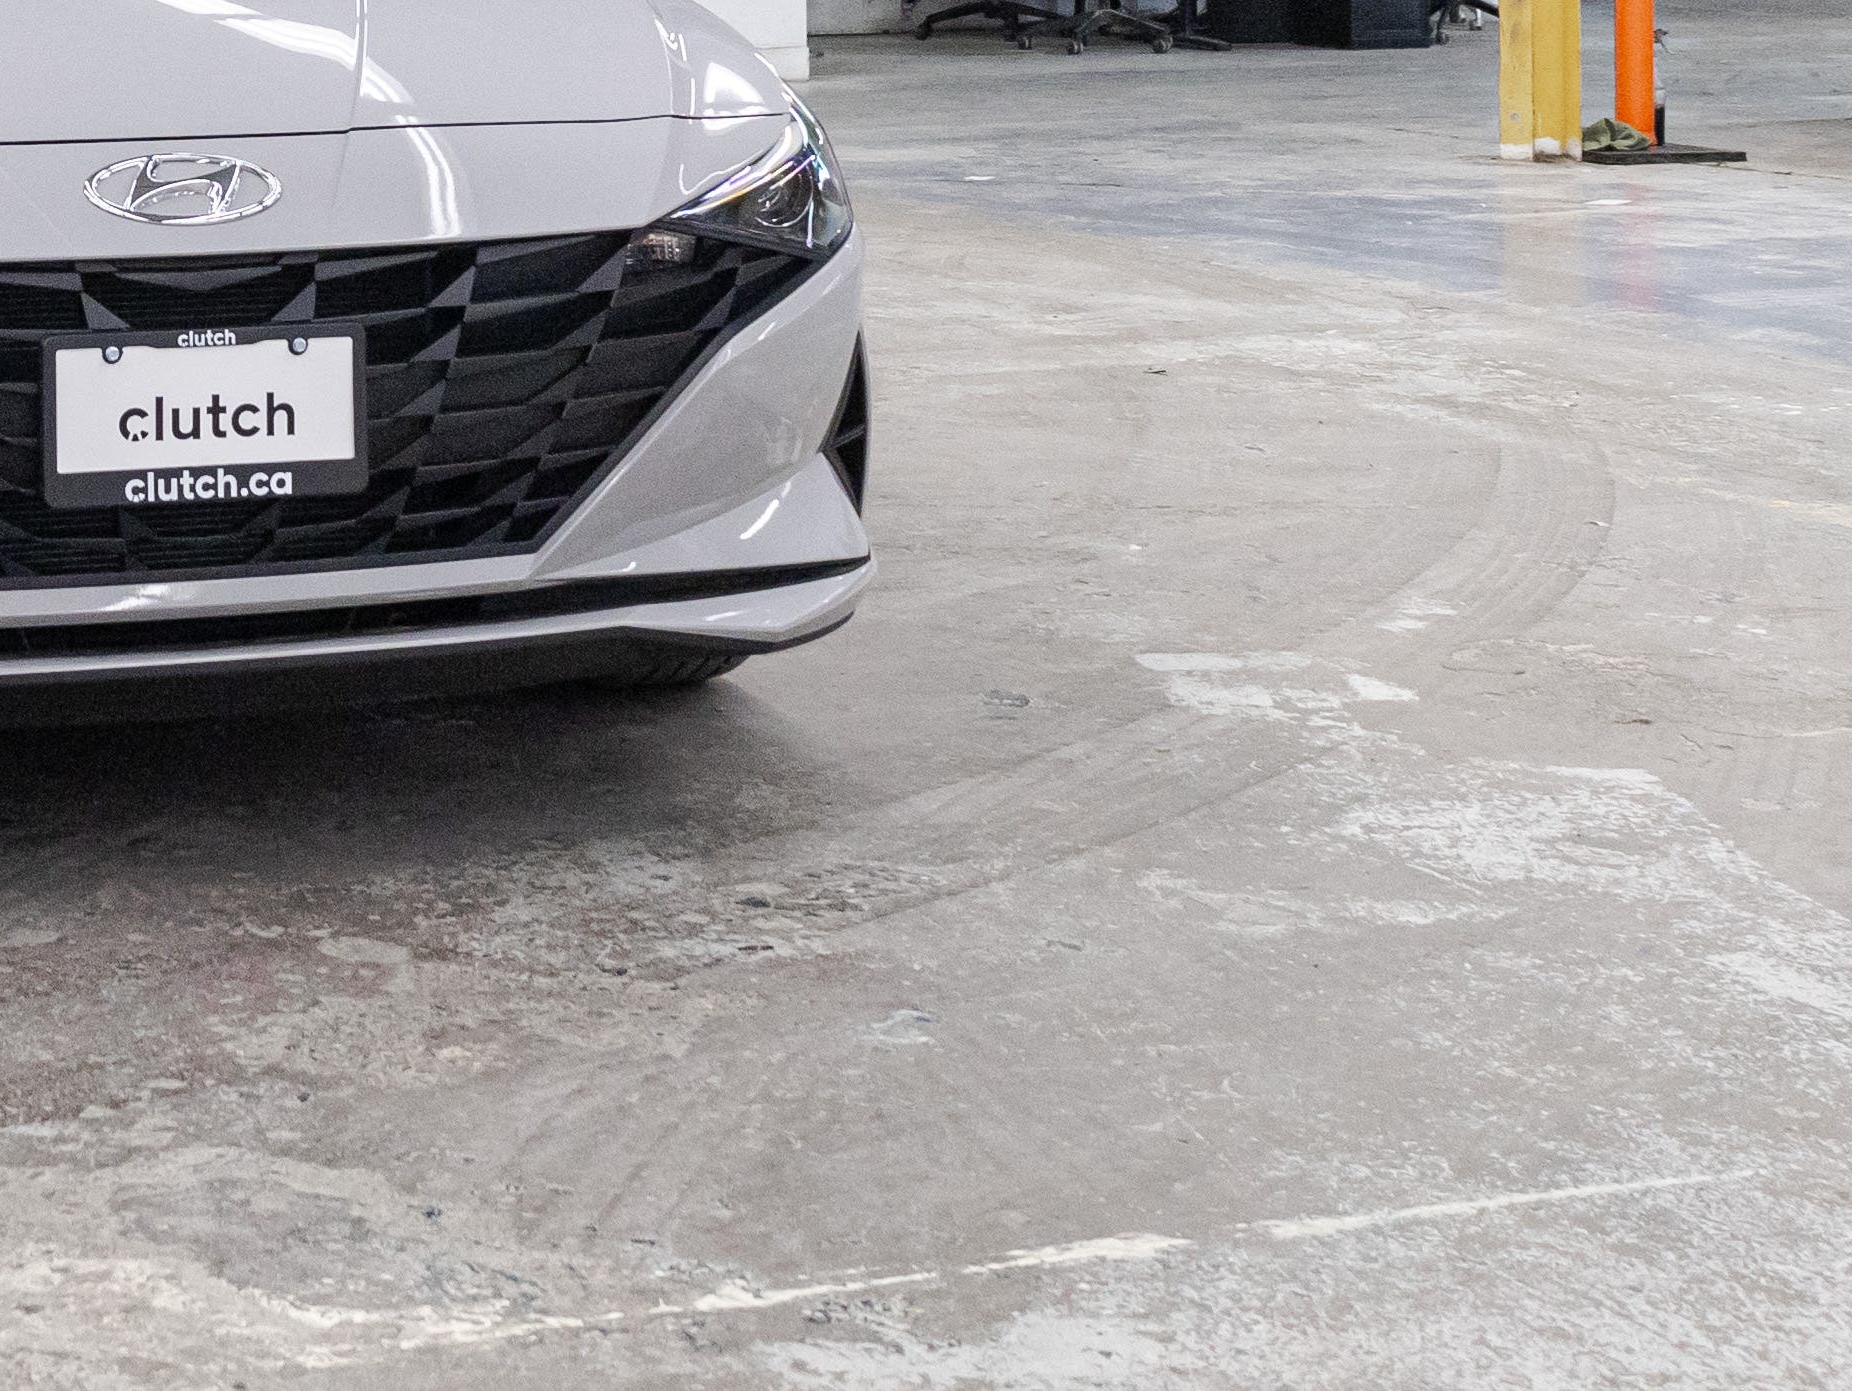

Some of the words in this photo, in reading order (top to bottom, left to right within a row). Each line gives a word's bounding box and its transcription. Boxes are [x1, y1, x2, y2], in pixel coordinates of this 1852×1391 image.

[176, 328, 236, 348] clutch
[118, 391, 296, 442] clutch
[124, 467, 294, 503] clutch.ca
